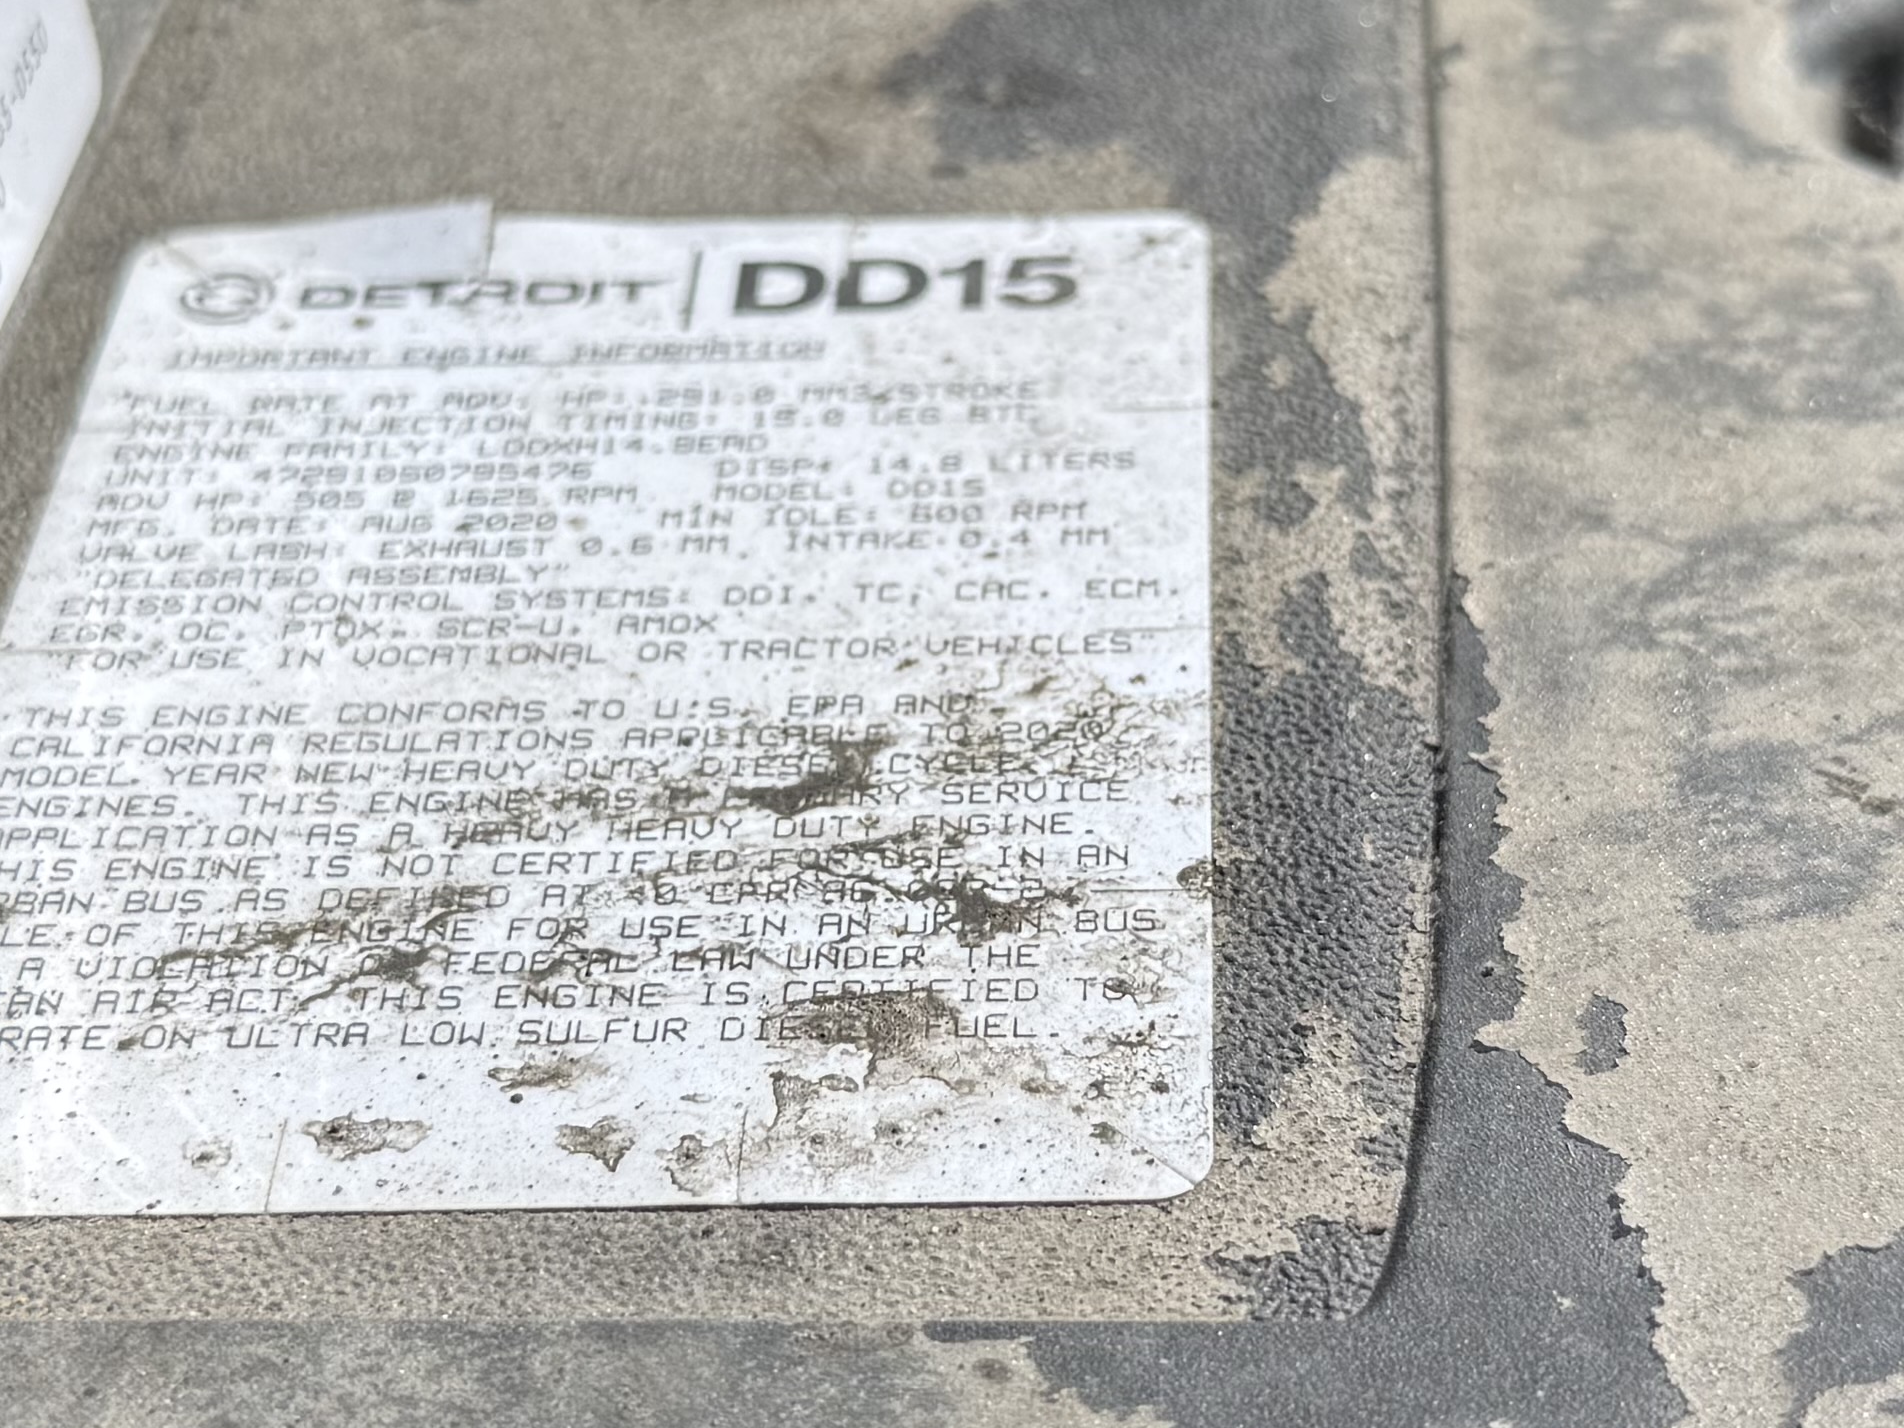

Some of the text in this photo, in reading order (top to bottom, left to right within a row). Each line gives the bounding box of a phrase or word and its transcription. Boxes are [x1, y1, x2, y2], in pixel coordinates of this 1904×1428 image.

[296, 258, 1080, 313] DETROIT DD15
[167, 341, 826, 370] IMPORTANT ENGINE INFORMATION
[248, 392, 345, 414] RATE
[367, 390, 413, 412] AT
[127, 416, 284, 439] INITIAL
[318, 414, 533, 438] INJECTION
[559, 410, 718, 433] TIMING:
[104, 466, 219, 489] UNIT:
[868, 453, 963, 476] 14.8
[986, 449, 1136, 473] LITERS
[112, 442, 253, 464] ENGINE
[282, 440, 444, 462] FAMILY:
[192, 491, 262, 513] HP:
[294, 488, 366, 511] 505
[444, 487, 539, 510] 1625
[563, 484, 639, 506] RPM
[713, 480, 855, 503] MODEL:
[209, 515, 328, 538] DATE:
[360, 513, 434, 535] AUG
[460, 510, 559, 534] 2020
[659, 508, 733, 529] MIN
[764, 505, 878, 527] IDLE:
[1010, 500, 1089, 523] RPM
[77, 525, 1112, 564] VALVE LASH: EXHAUST 0.6 0.4 MM
[75, 562, 572, 592] "DELEGATED ASSEMBLY"
[58, 593, 263, 618] EMISSION
[288, 590, 464, 616] CONTROL
[493, 586, 692, 611] SYSTEMS:
[615, 612, 719, 636] AMOX
[169, 647, 249, 670] USE
[277, 648, 326, 669] IN
[351, 642, 608, 668] VOCATIONAL
[637, 640, 689, 664] OR
[719, 637, 897, 662] TRACTOR
[24, 705, 127, 730] THIS
[151, 703, 312, 727] ENGINE
[337, 699, 546, 726] CONFORMS
[577, 699, 626, 721] TO
[786, 693, 864, 717] EPA
[893, 693, 970, 716] AND
[9, 719, 1104, 759] CALIFORNIA REGULATIONS APPLICABLE TO 2020
[163, 761, 267, 786] YEAR
[294, 760, 378, 785] NEW
[400, 759, 536, 783] HEAVY
[563, 757, 670, 781] DUTY
[696, 753, 858, 778] DIESE
[239, 792, 339, 815] THIS
[369, 790, 525, 815] ENGINE
[941, 779, 1131, 805] SERVICE
[304, 822, 359, 847] AS
[388, 821, 414, 846] A
[444, 820, 579, 846] HEAVY
[608, 817, 744, 843] HEAVY
[773, 814, 881, 839] DUTY
[911, 812, 1095, 837] ENGINE.
[104, 856, 270, 881] ENGINE
[301, 855, 352, 878] IS
[381, 853, 463, 878] NOT
[492, 850, 737, 877] CERTIFIED
[770, 847, 847, 871] FOR
[879, 846, 962, 870] USE
[997, 844, 1046, 869] IN
[1076, 842, 1131, 867] AN
[122, 888, 209, 913] BUS
[234, 888, 290, 912] AS
[316, 885, 511, 911] DEFINED
[540, 883, 591, 907] AT
[710, 880, 789, 905] CFR
[85, 922, 140, 946] OF
[174, 920, 281, 946] THIS
[309, 917, 478, 945] ENGINE
[506, 917, 590, 943] FOR
[619, 914, 702, 941] USE
[738, 913, 787, 939] IN
[817, 912, 872, 937] AN
[1074, 908, 1157, 934] BUS
[16, 957, 46, 982] A
[76, 954, 329, 982] VIOLATION
[444, 949, 639, 977] FEDERAL
[671, 948, 755, 973] LAW
[786, 944, 925, 971] UNDER
[960, 943, 1041, 969] THE
[95, 990, 179, 1015] AIR
[358, 985, 464, 1012] THIS
[494, 981, 664, 1009] ENGINE
[699, 981, 750, 1007] IS
[782, 977, 1040, 1005] CERTIFIED
[1078, 975, 1131, 1002] TO
[140, 1022, 196, 1050] ON
[225, 1021, 370, 1049] ULTRA
[399, 1021, 486, 1047] LOW
[517, 1017, 690, 1044] SULFUR
[925, 1012, 1059, 1040] FUEL.
